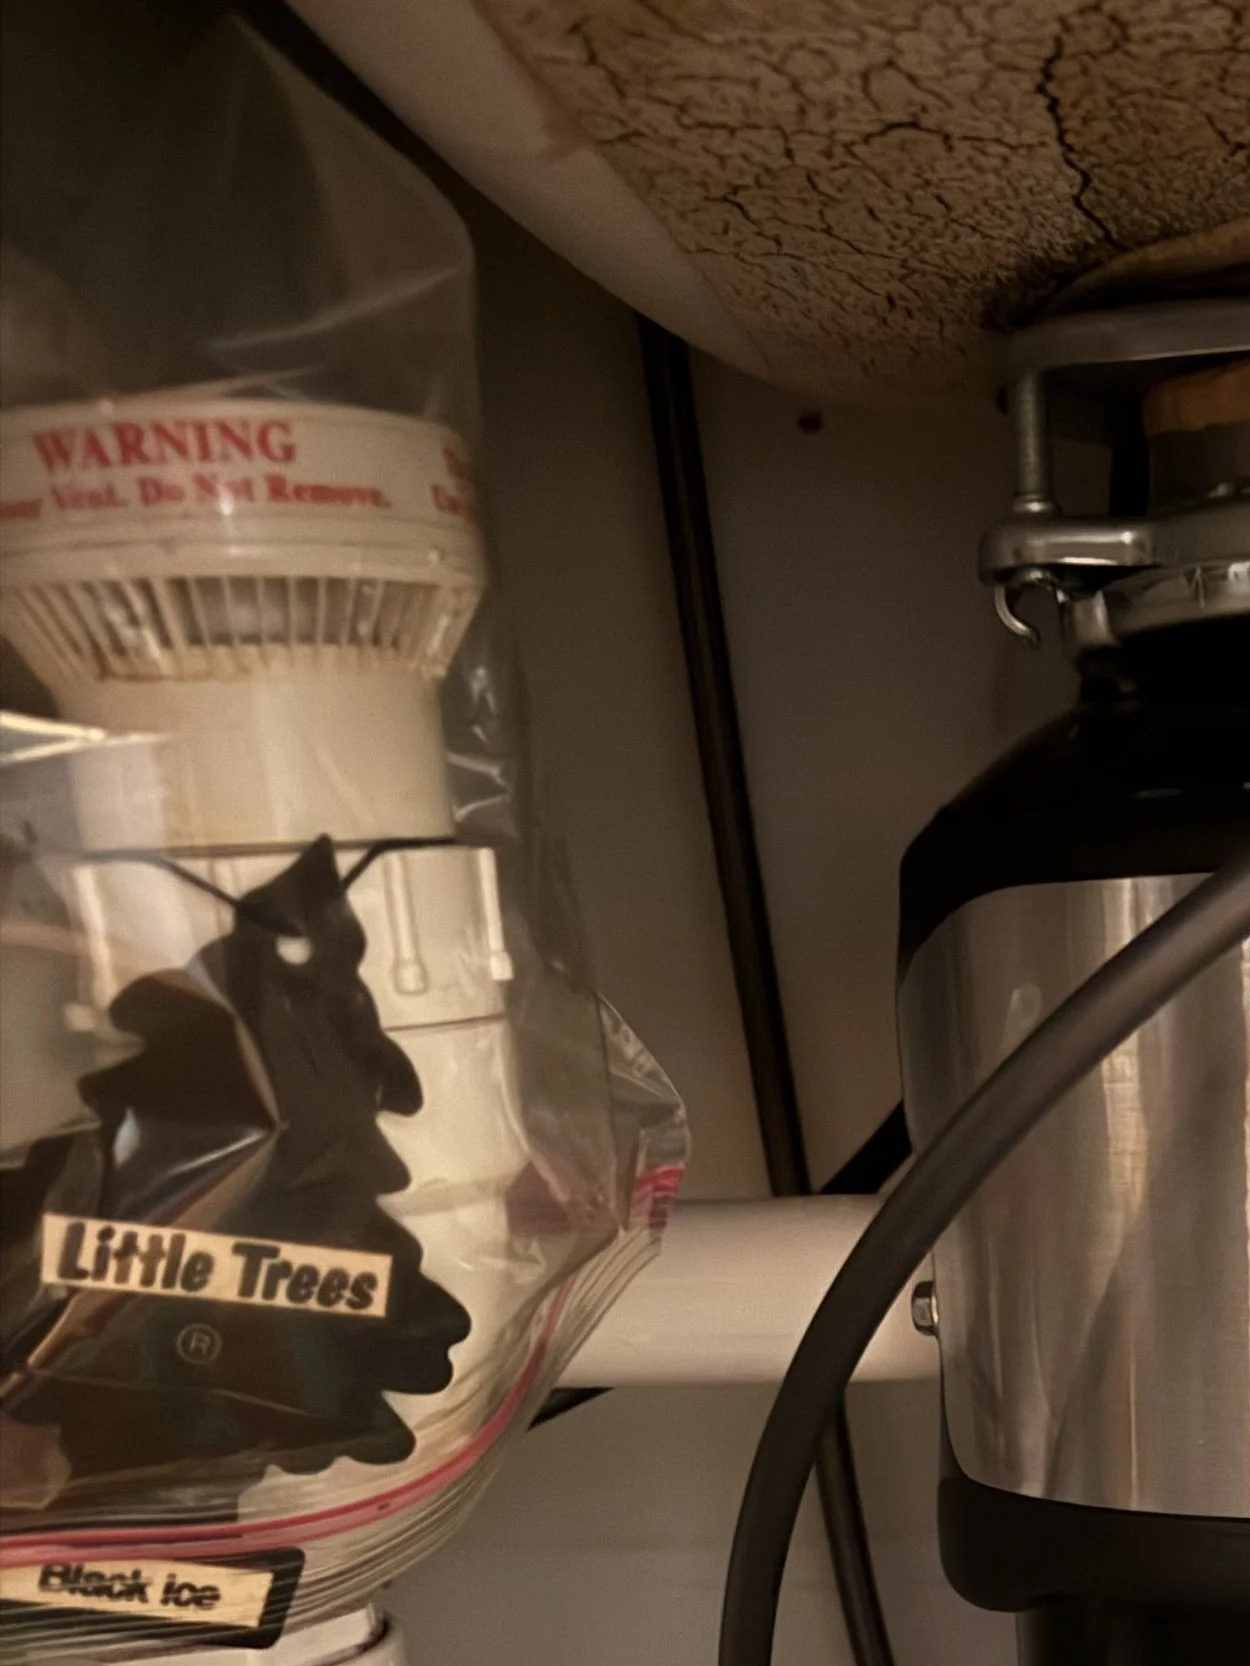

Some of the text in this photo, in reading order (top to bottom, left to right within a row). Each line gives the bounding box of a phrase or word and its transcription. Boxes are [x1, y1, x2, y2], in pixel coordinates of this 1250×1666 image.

[32, 419, 296, 476] WARNING
[56, 1221, 378, 1311] Little Trees
[38, 1562, 152, 1604] Black
